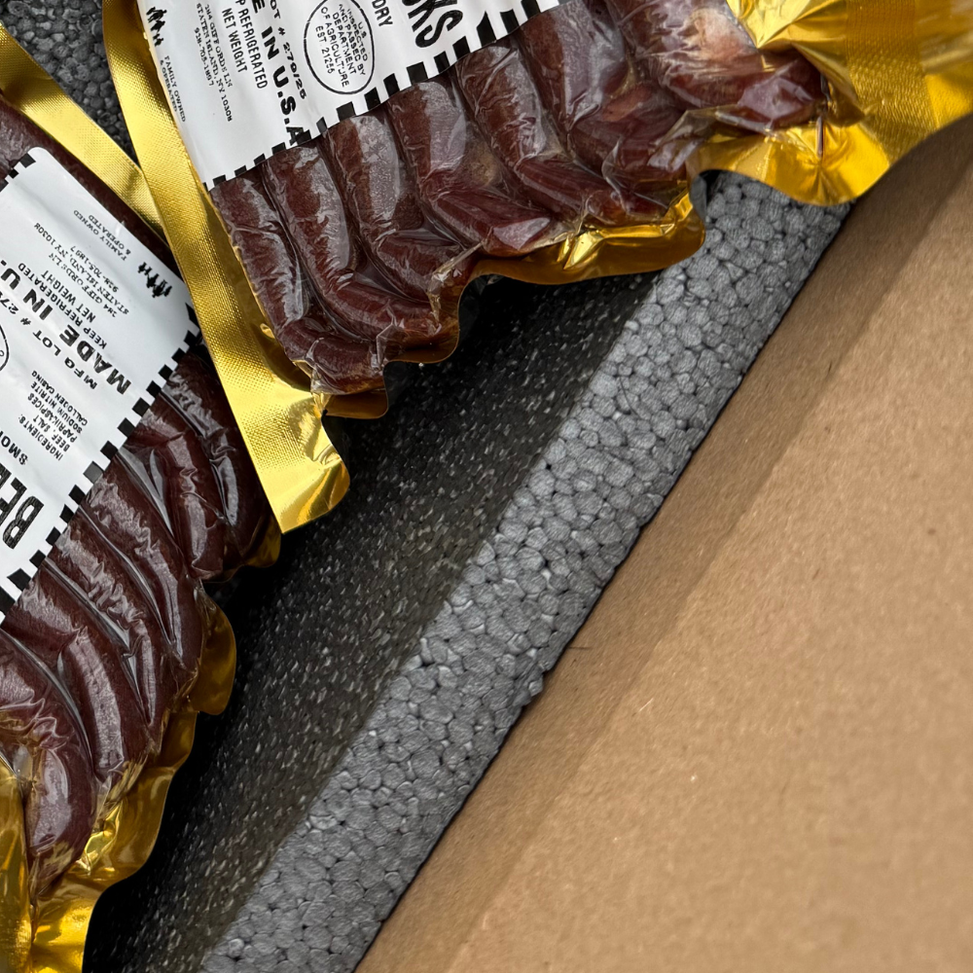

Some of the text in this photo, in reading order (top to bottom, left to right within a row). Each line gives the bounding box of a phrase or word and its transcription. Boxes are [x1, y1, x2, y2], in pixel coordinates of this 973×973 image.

[221, 8, 248, 73] NET WEIGHT
[238, 8, 268, 89] REFRIGERATED
[261, 26, 280, 60] IN
[278, 24, 286, 36] #
[325, 22, 350, 87] AGRICULTURE
[332, 12, 357, 74] DEPARTMENT
[338, 4, 366, 75] AND PASSED BY
[346, 8, 368, 62] INSPECTED
[163, 55, 186, 122] FAMILY OWNED
[216, 78, 225, 93] NY
[55, 244, 69, 257] NY
[73, 210, 127, 261] FAMILY OWNED
[88, 215, 125, 250] OPERATED
[18, 263, 107, 350] KEEP REFRIGERATED
[21, 315, 32, 326] #
[23, 288, 53, 320] IN
[41, 270, 96, 323] NET WEIGHT
[32, 330, 61, 356] LOT
[59, 324, 132, 395] MADE
[64, 357, 98, 390] MFG
[31, 381, 83, 434] SODIUM NITRITE
[33, 415, 51, 432] SALT
